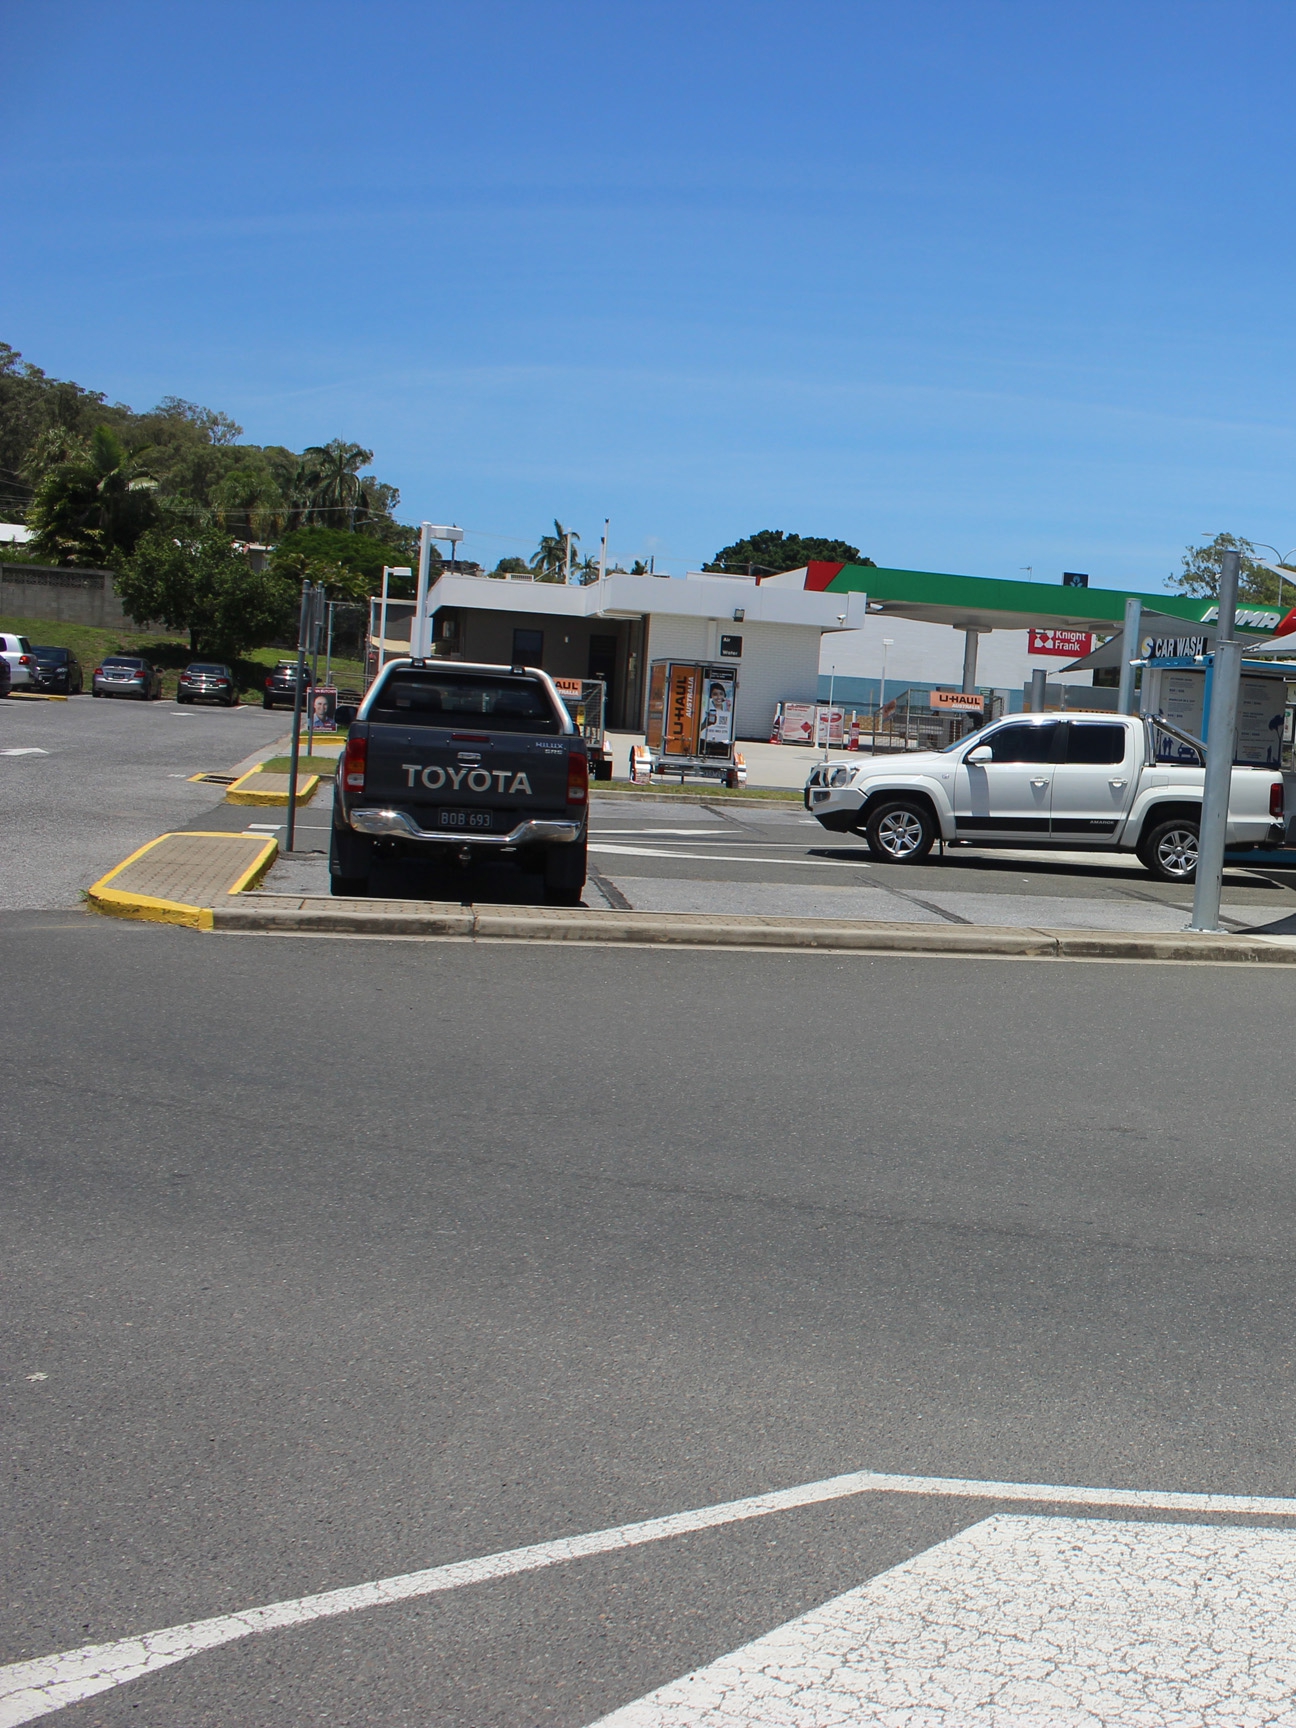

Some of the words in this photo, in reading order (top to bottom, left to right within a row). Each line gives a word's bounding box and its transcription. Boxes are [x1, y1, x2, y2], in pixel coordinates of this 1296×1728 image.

[1055, 630, 1086, 643] Knight
[1054, 640, 1081, 651] Frank
[1155, 637, 1176, 658] CAR
[1176, 636, 1204, 658] WASH
[556, 681, 579, 690] AUL
[685, 676, 695, 718] AUSTRALIA
[939, 694, 980, 705] U-HAUL
[402, 763, 533, 795] TOYOTA
[469, 813, 490, 827] 693
